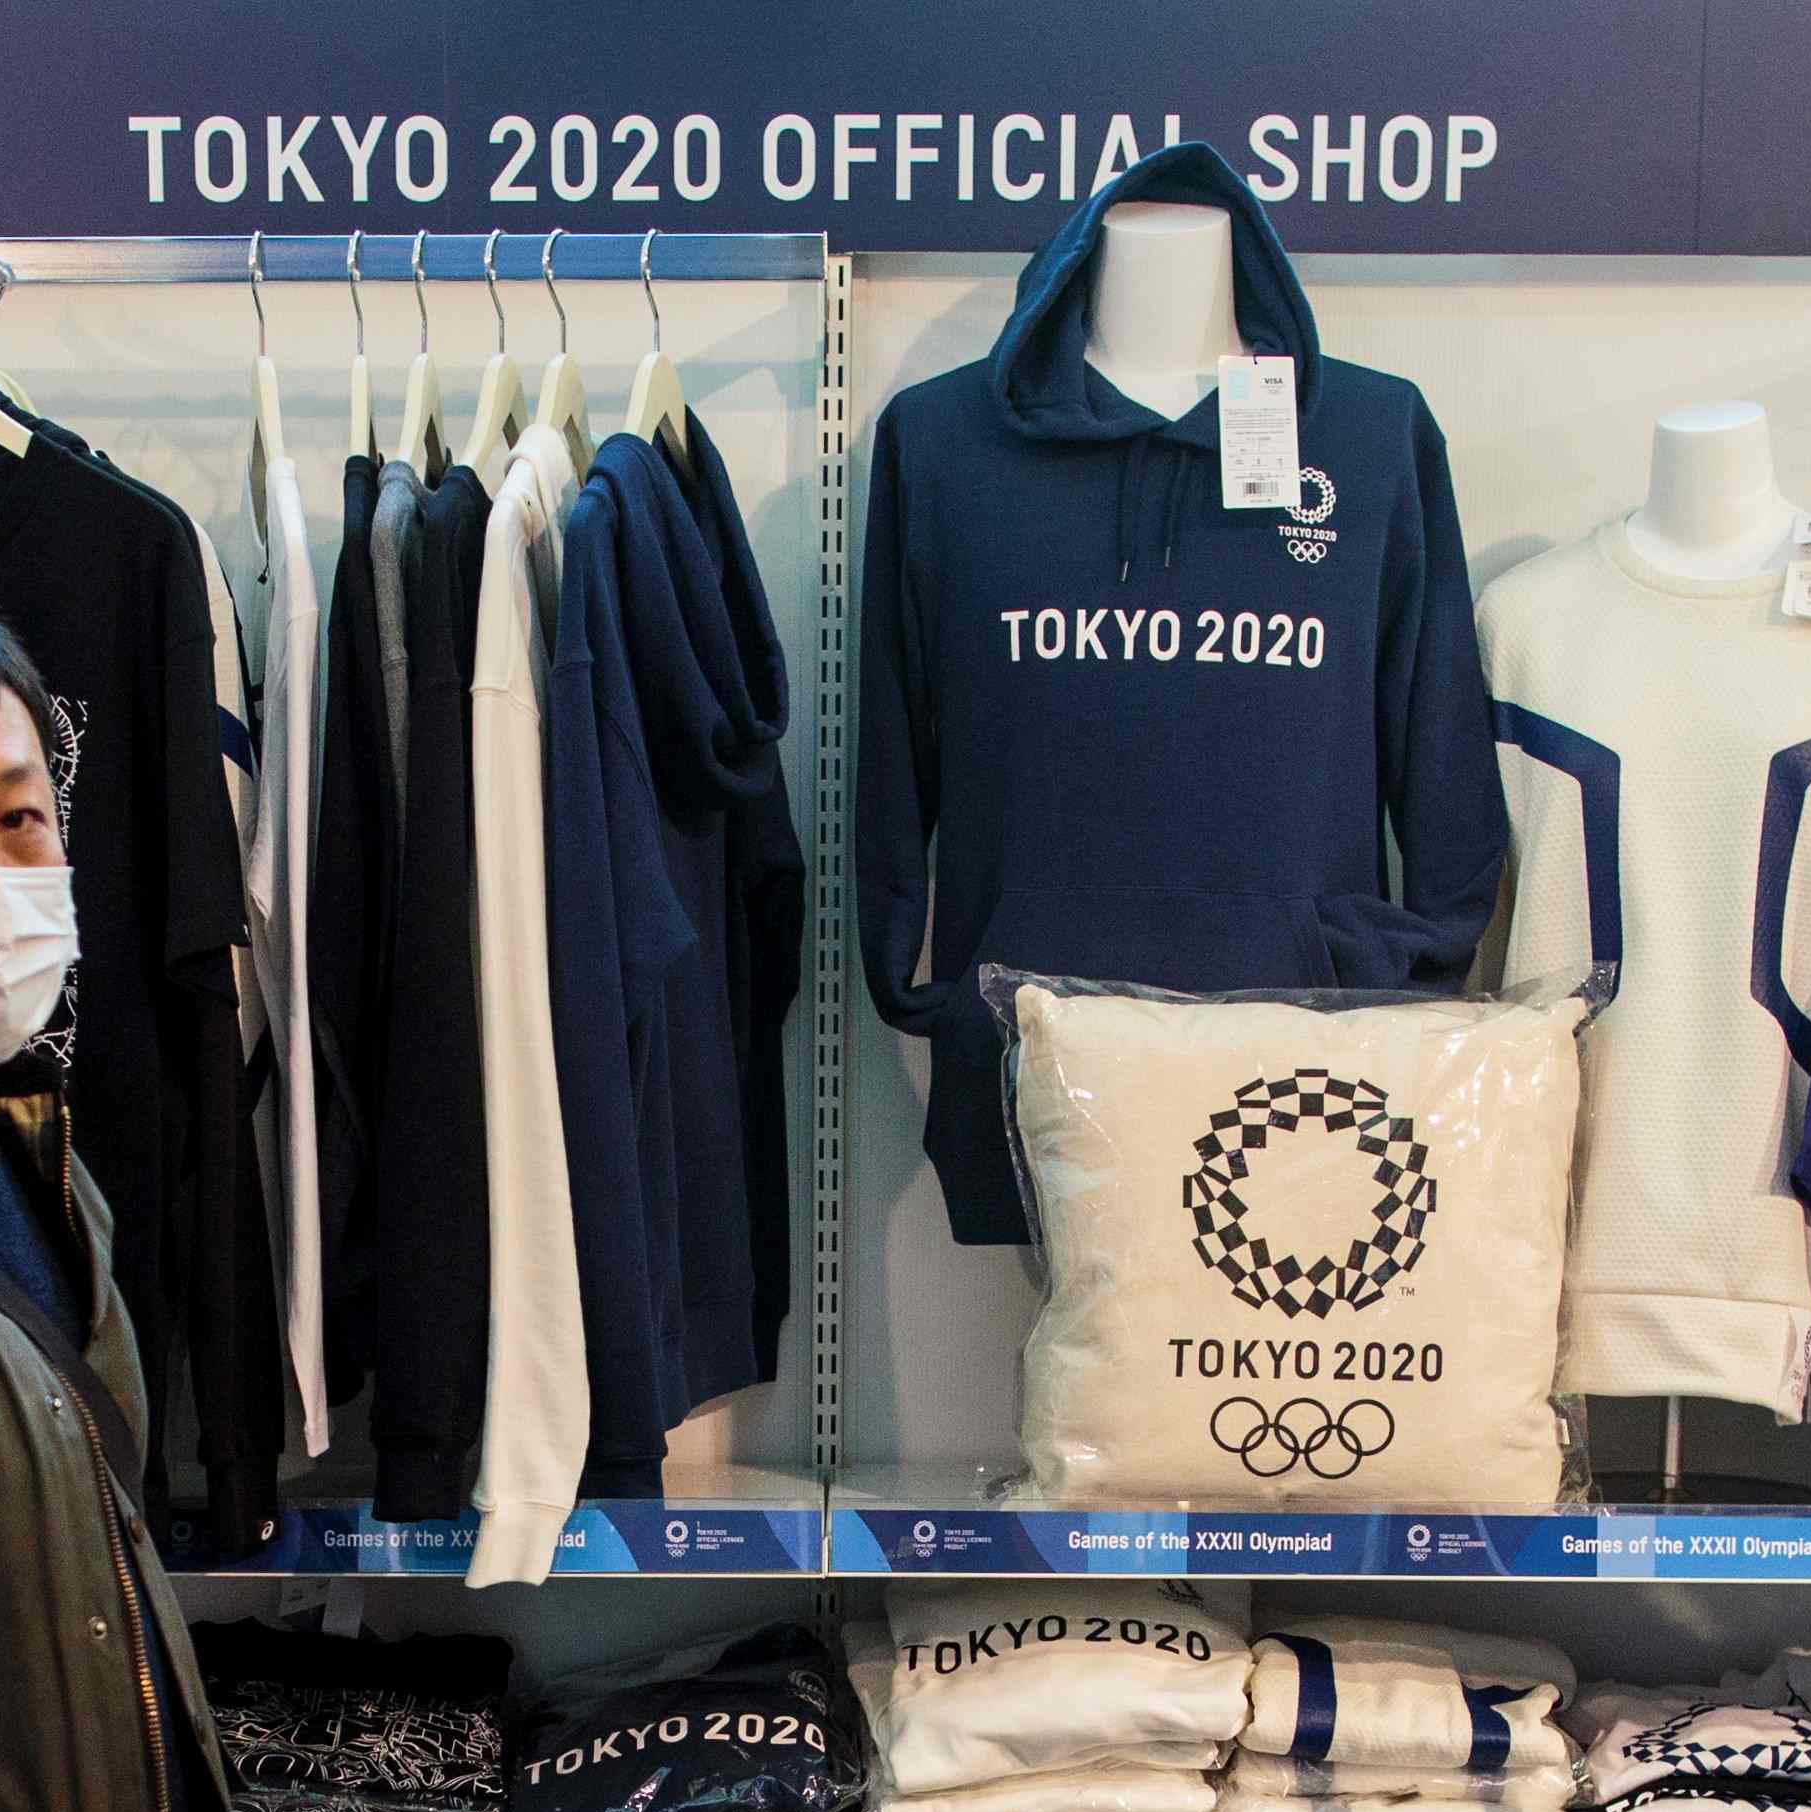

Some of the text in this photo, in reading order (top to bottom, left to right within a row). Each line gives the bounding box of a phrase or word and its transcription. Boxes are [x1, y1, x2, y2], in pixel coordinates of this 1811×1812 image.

[128, 115, 449, 202] TOKYO
[489, 114, 722, 202] 2020
[1246, 114, 1498, 202] SHOP
[1277, 525, 1337, 542] TOKYO 2020
[1000, 607, 1325, 669] TOKYO 2020
[1399, 1286, 1416, 1297] TM
[1168, 1337, 1444, 1382] TOKYO 2020
[324, 1529, 384, 1548] Games
[390, 1529, 412, 1548] of
[415, 1529, 445, 1548] the
[1068, 1531, 1332, 1554] Games of the XXXII Olympiad
[1562, 1535, 1622, 1554] Games
[1628, 1535, 1648, 1554] of
[1653, 1535, 1683, 1554] the
[1689, 1535, 1736, 1554] XXXII
[902, 1614, 1213, 1676] TOKYO 2020
[523, 1711, 826, 1788] TOKYO 2020
